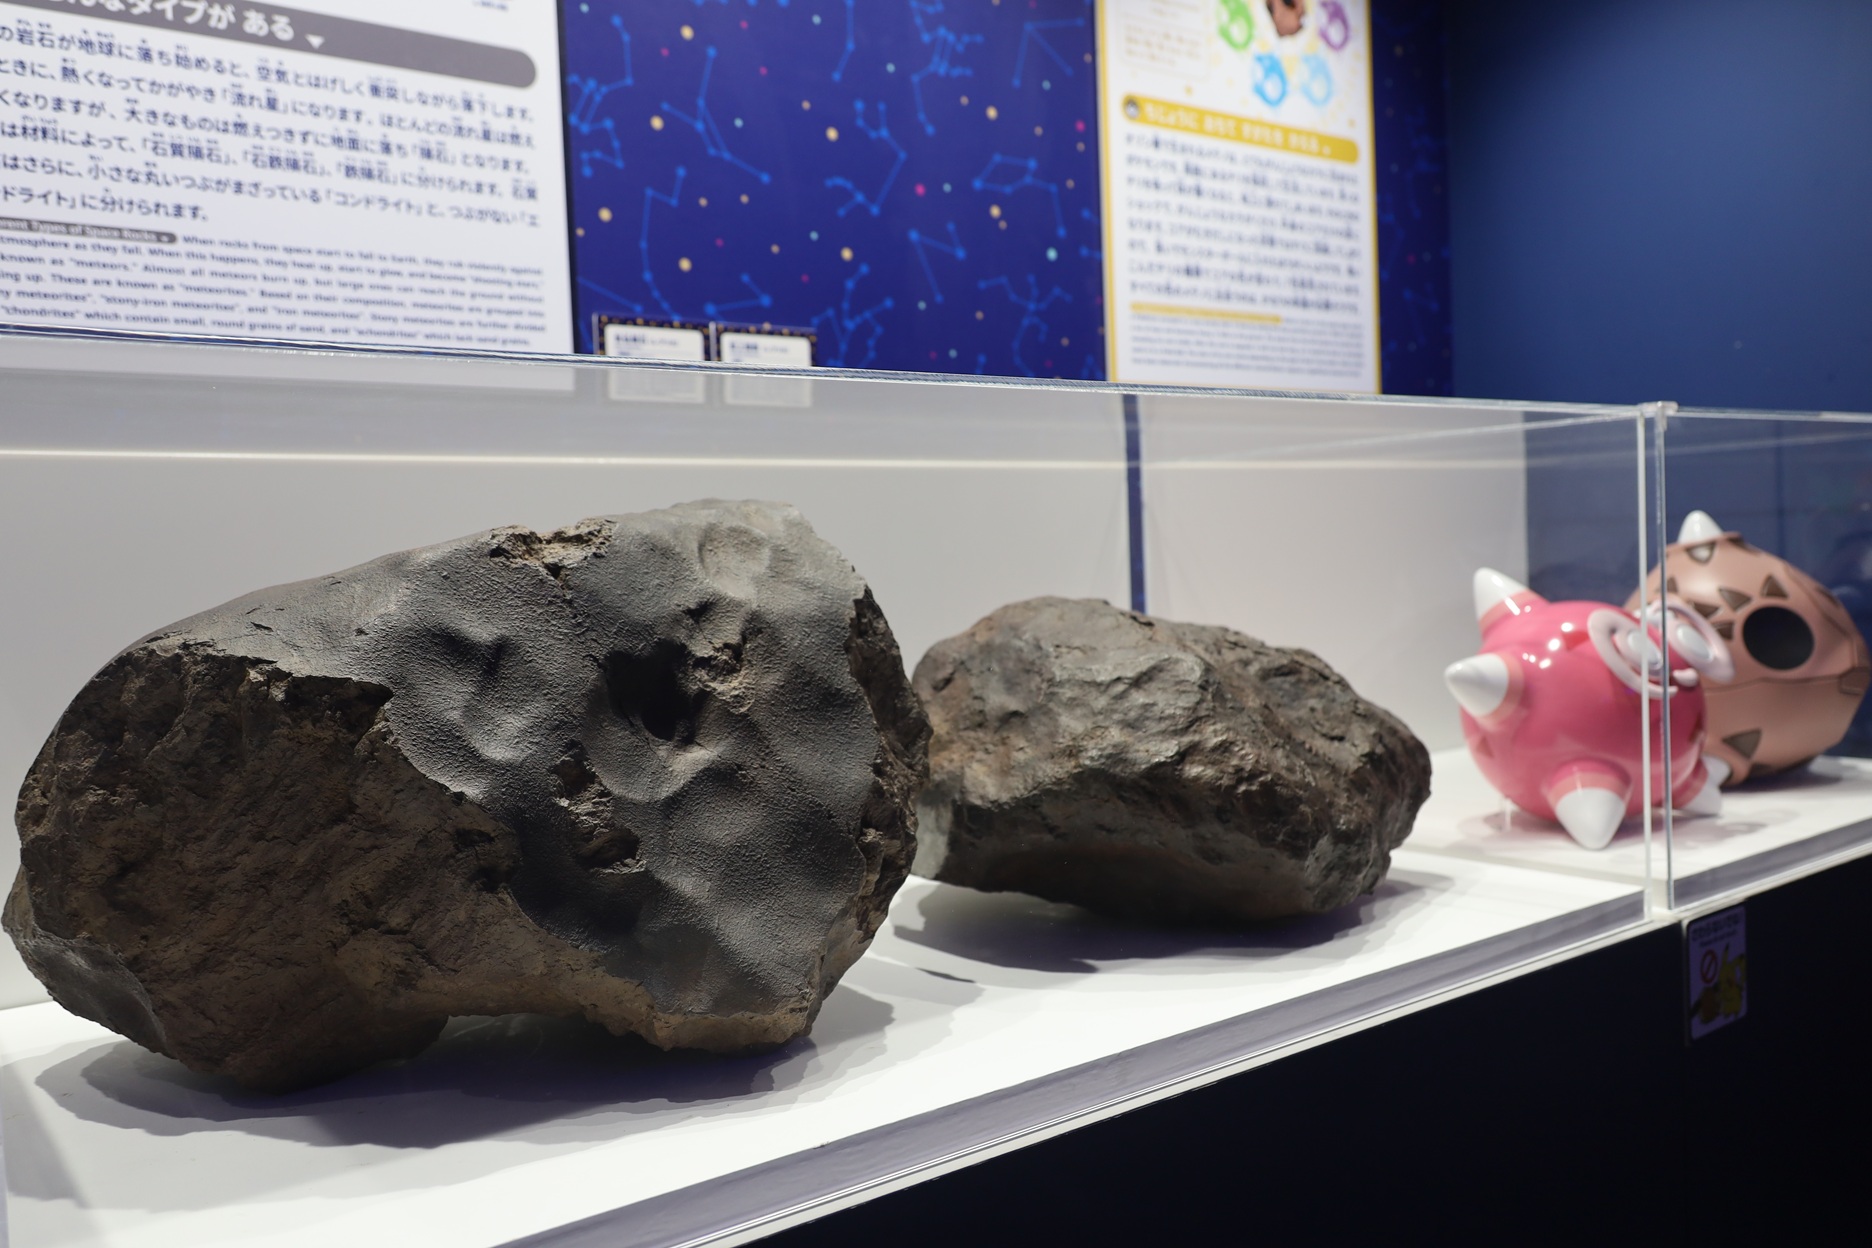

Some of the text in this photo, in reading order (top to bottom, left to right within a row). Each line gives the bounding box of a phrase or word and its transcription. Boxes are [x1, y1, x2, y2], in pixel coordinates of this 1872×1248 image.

[242, 9, 294, 41] ある
[148, 247, 181, 259] When
[1, 251, 45, 264] known
[143, 263, 185, 275] Almost
[51, 273, 87, 285] These
[117, 277, 157, 289] known
[85, 310, 121, 321] which
